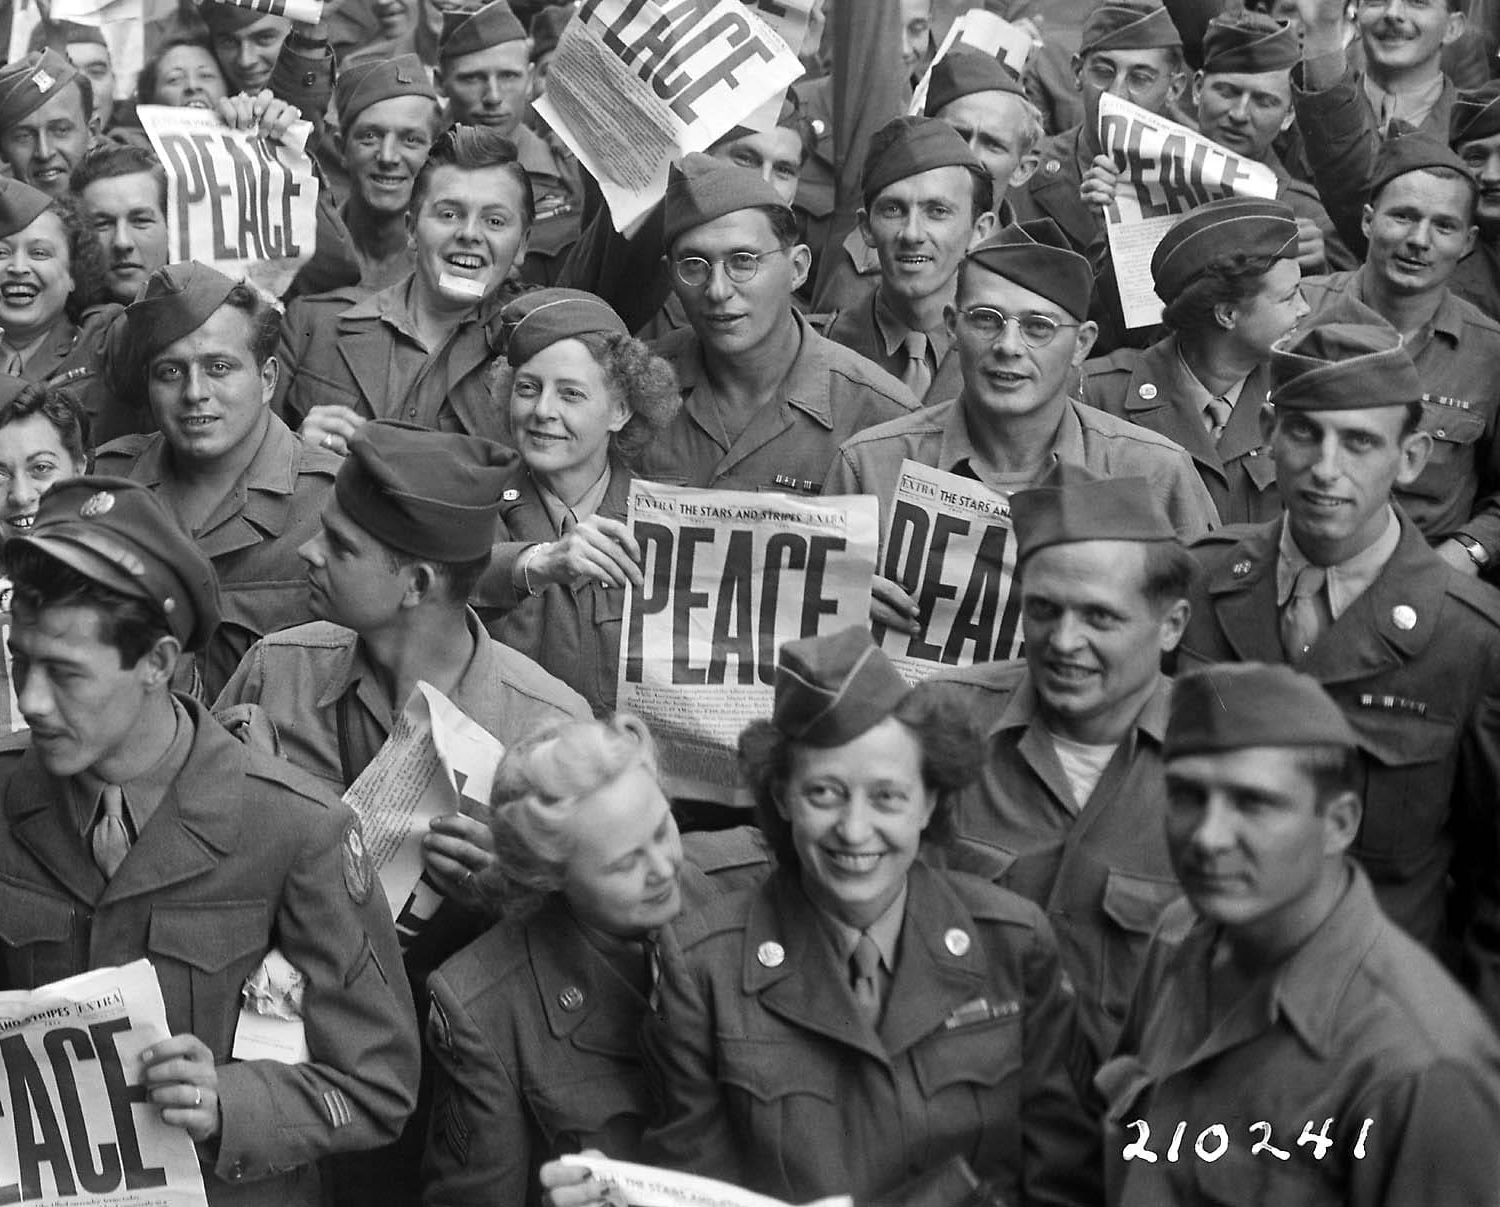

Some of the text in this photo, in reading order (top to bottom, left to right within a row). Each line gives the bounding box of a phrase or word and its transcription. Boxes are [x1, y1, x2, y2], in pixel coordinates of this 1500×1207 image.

[159, 135, 301, 262] PEACE
[635, 497, 675, 512] EXTRA
[679, 503, 698, 516] THE
[700, 505, 733, 519] STARS
[735, 508, 759, 520] AND
[759, 509, 802, 523] STRIPES
[901, 477, 934, 497] EXTRA
[940, 489, 957, 506] THE
[959, 495, 990, 513] STARS
[625, 519, 848, 686] PEACE
[25, 1006, 71, 1024] STRIPES
[77, 993, 122, 1012] EXTRA
